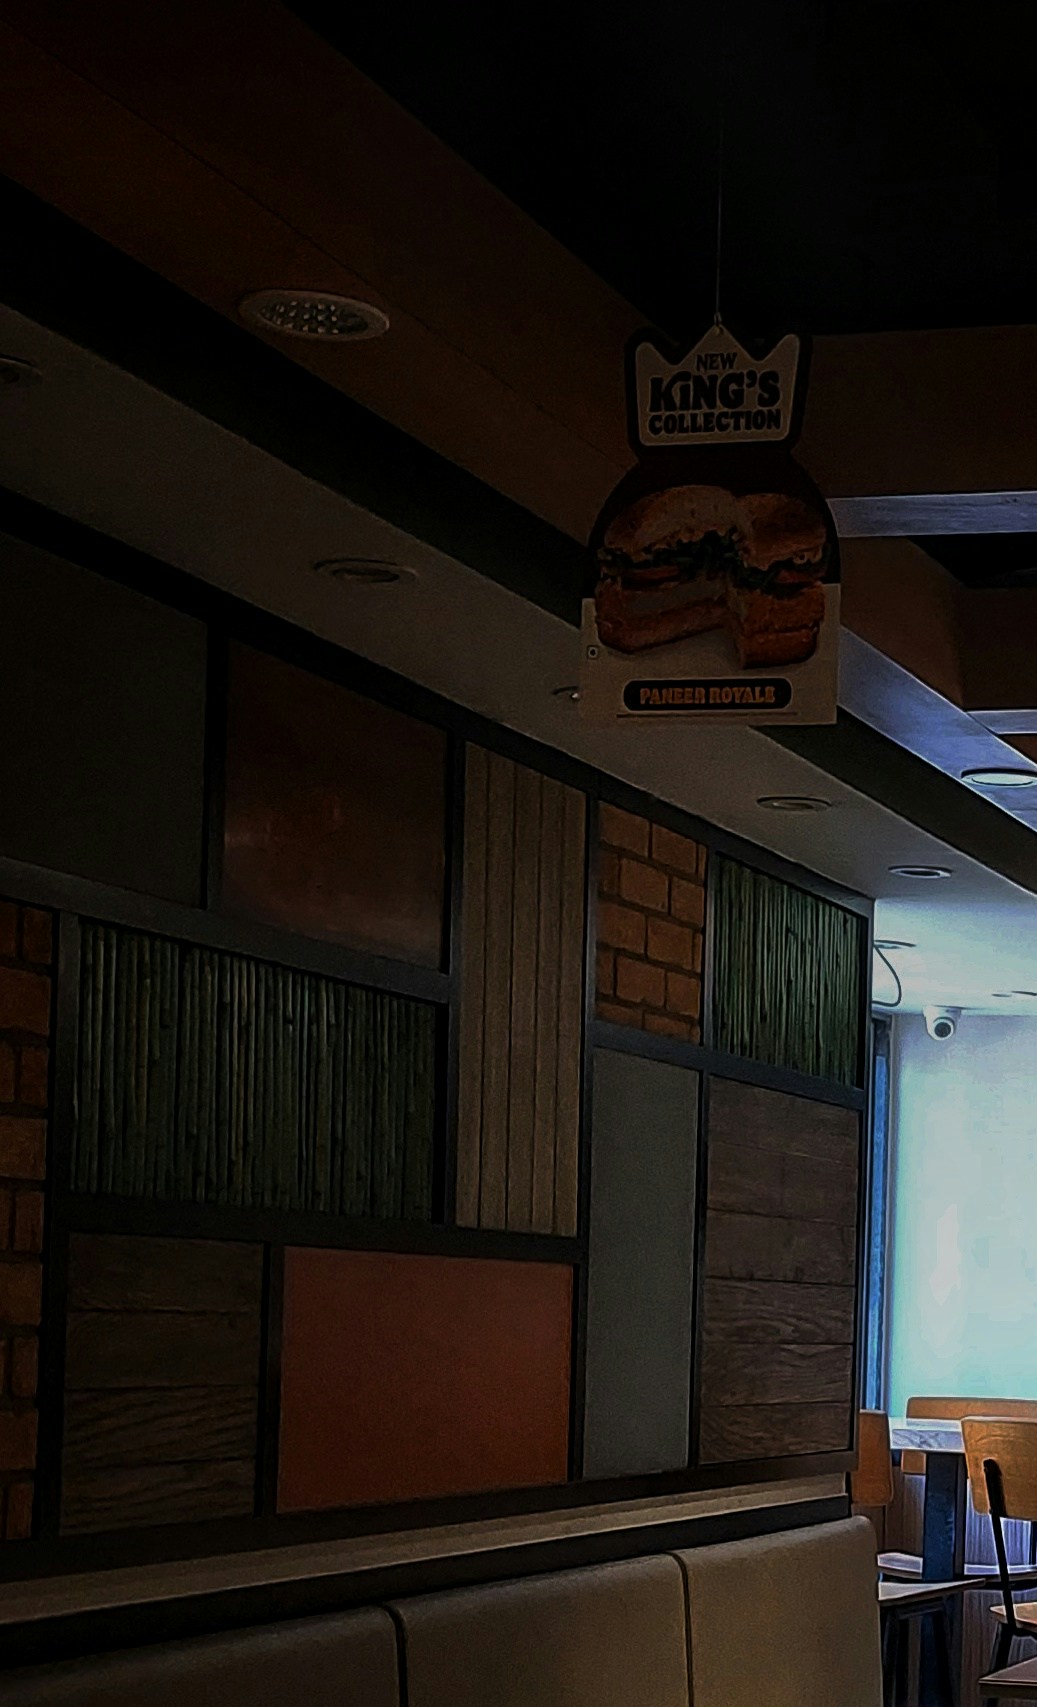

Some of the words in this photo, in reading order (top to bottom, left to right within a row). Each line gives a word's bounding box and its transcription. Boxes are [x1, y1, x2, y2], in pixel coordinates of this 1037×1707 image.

[696, 353, 738, 370] NEW
[649, 409, 781, 435] COLLECTION
[639, 686, 706, 706] PANEER
[708, 685, 776, 705] ROYALE
